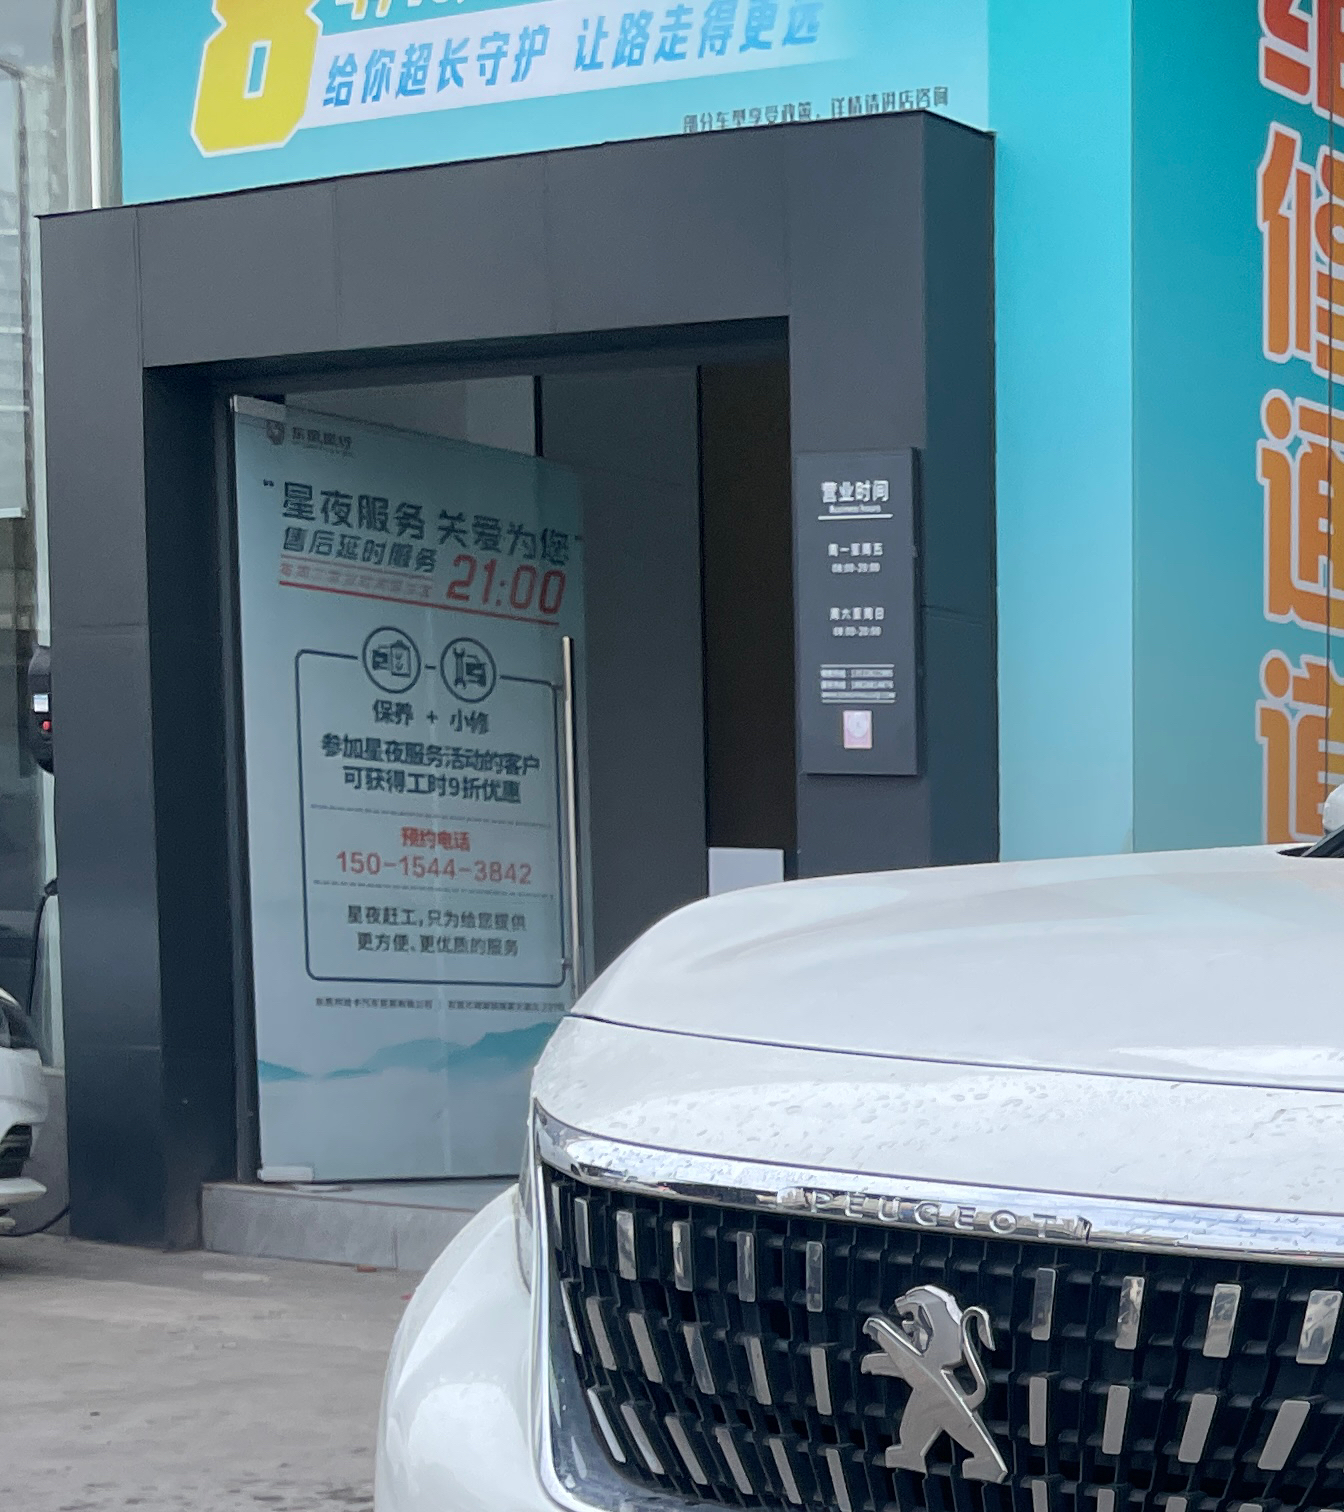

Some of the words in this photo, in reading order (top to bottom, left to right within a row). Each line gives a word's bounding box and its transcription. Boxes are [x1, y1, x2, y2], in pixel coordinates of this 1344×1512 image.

[322, 23, 551, 108] 给你超长守护
[573, 0, 823, 71] 让路走得更远
[821, 480, 889, 503] 营业时间
[282, 526, 438, 574] 售后延时服务
[445, 553, 567, 616] 21:00
[372, 698, 414, 726] 保养
[450, 708, 489, 735] 小修
[321, 733, 541, 776] 参加星夜服务活动的客户
[343, 765, 522, 804] 可获得工时9折优惠
[401, 826, 471, 852] 预约电话
[809, 1189, 1058, 1239] PEUGEOT
